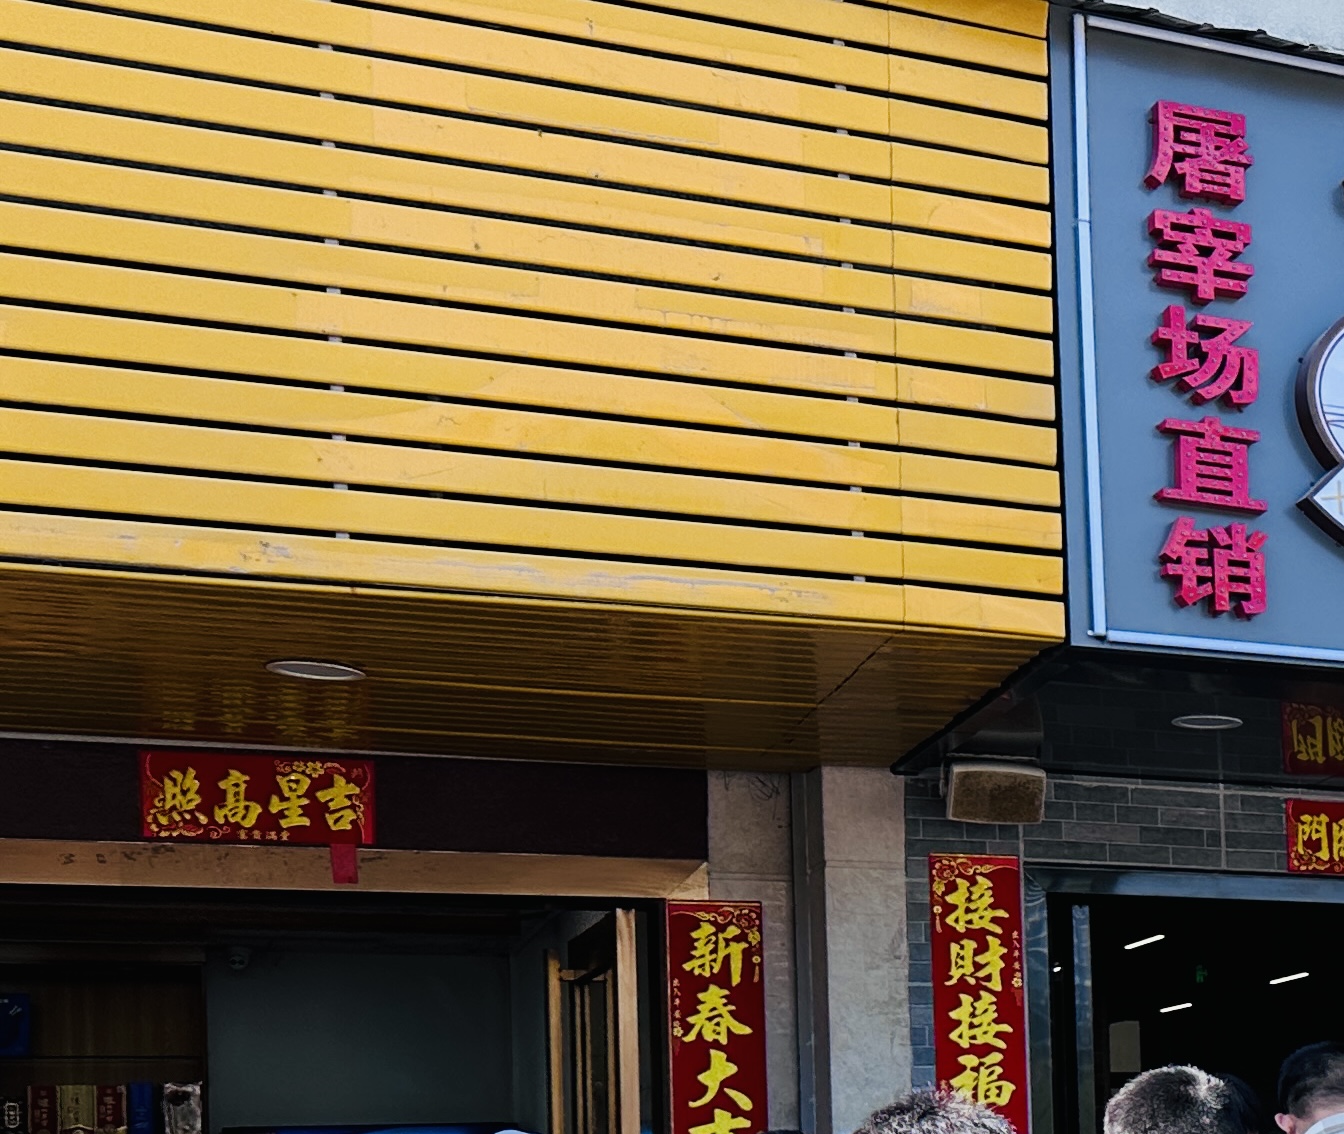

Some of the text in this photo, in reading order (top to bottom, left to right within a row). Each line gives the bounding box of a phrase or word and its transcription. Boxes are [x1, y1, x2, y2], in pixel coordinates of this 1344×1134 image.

[1143, 100, 1268, 621] 屠宰场直销
